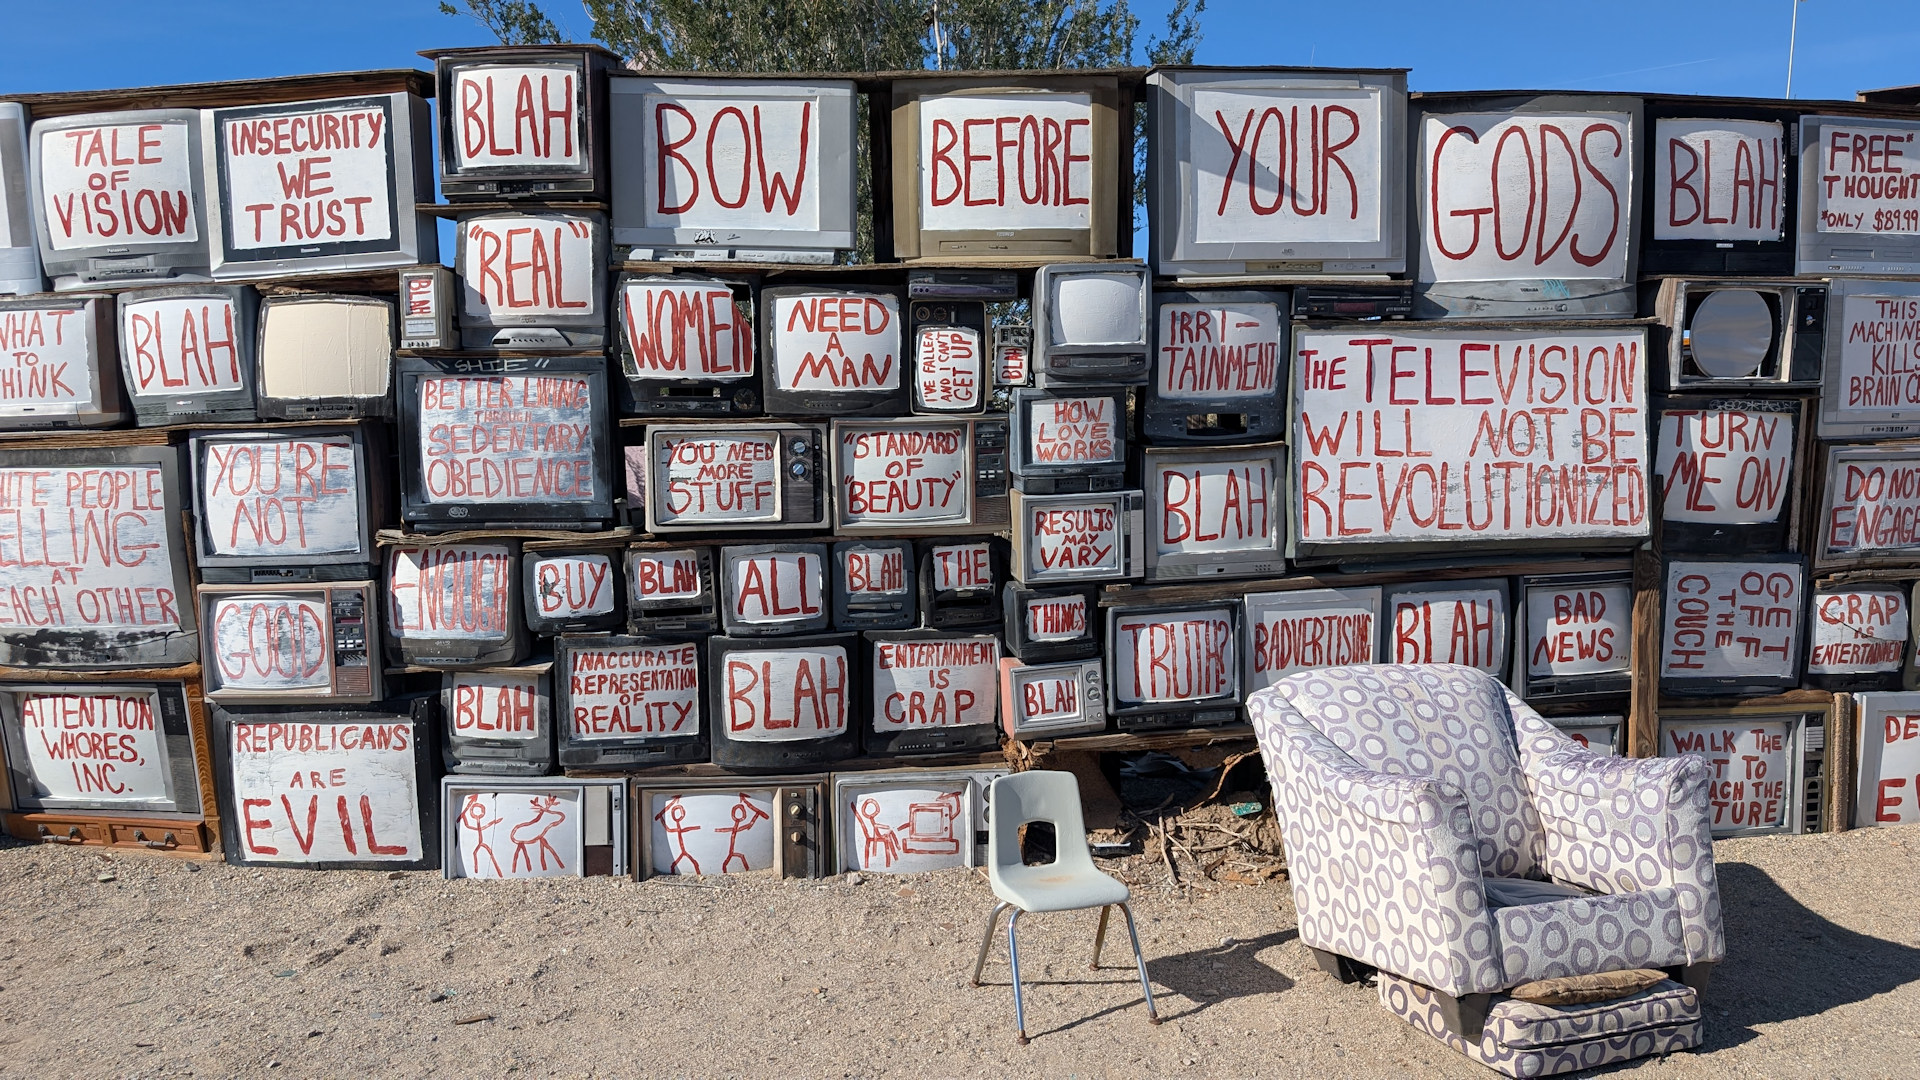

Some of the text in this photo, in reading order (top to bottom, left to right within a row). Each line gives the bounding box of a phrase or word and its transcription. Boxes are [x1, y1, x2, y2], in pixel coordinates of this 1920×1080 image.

[231, 113, 383, 156] INSECURITY
[462, 74, 572, 159] BLAH
[66, 125, 163, 167] TALE
[656, 102, 811, 216] BOW
[932, 114, 1090, 207] BEFORE
[1215, 105, 1359, 220] YOUR
[88, 170, 130, 191] OF
[278, 157, 333, 199] WE
[1432, 123, 1622, 267] GODS
[1669, 138, 1778, 230] BLAH
[53, 189, 188, 237] VISION
[245, 197, 372, 242] TRUST
[1872, 207, 1919, 232] $89.99
[469, 221, 589, 309] "REAL"
[409, 279, 431, 315] BLAH
[786, 297, 890, 335] NEED
[1876, 300, 1918, 320] THIS
[132, 303, 239, 390] BLAH
[624, 289, 753, 374] WOMEN
[826, 332, 844, 357] A
[936, 331, 950, 362] CAN'T
[13, 351, 39, 367] TO
[792, 351, 892, 388] MAN
[921, 331, 937, 403] I'VE FALLEN
[950, 333, 974, 401] GET UP
[1001, 347, 1024, 380] BLAH
[1162, 341, 1277, 392] TAINMENT
[1298, 338, 1637, 406] THE TELEVISION
[0, 361, 75, 399] HINK
[425, 376, 589, 411] BETTER LIVING
[940, 377, 952, 402] AND
[1848, 375, 1902, 407] BRAIN
[474, 410, 532, 424] THROUGH
[1054, 400, 1105, 424] HOW
[427, 423, 590, 456] SEDENTARY
[844, 429, 961, 459] "STANDARD"
[1036, 439, 1113, 462] WORKS
[1038, 423, 1109, 443] LOVE
[1301, 407, 1639, 465] WILL NOT BE
[1665, 410, 1778, 453] TURN
[211, 440, 350, 501] YOU'RE
[665, 438, 774, 467] YOU NEED
[696, 462, 753, 481] MORE
[885, 458, 924, 479] OF
[66, 470, 164, 511] PEOPLE
[427, 458, 593, 498] OBEDIENCE
[844, 471, 961, 514] "BEAUTY"
[1662, 451, 1786, 512] ME ON
[1845, 464, 1886, 502] DO
[666, 480, 772, 515] STUFF
[1162, 467, 1267, 544] BLAH
[1301, 460, 1646, 536] REVOLUTIONIZED
[231, 496, 318, 549] NOT
[1034, 508, 1113, 536] RESULTS
[1061, 533, 1099, 546] MAY
[1830, 504, 1920, 546] ENGAGE
[848, 547, 902, 592] BLAH
[935, 543, 990, 587] THE
[1040, 544, 1113, 569] VARY
[51, 567, 83, 585] AT
[391, 549, 508, 633] ENOUGH
[538, 562, 607, 613] BUY
[639, 559, 698, 595] BLAH
[737, 556, 819, 616] ALL
[0, 586, 180, 627] EACH OTHER
[1029, 601, 1085, 634] THINGS
[1553, 590, 1607, 626] BAD
[1668, 574, 1711, 669] COUCH
[1715, 588, 1737, 647] THE
[1736, 571, 1764, 657] OFF
[1762, 572, 1793, 662] GET
[1819, 594, 1900, 627] CRAP
[214, 603, 325, 679] GOOD
[1253, 612, 1373, 674] BADVERTISING
[1395, 599, 1493, 667] BLAH
[1854, 626, 1875, 639] IS
[573, 646, 695, 673] INACCURATE
[878, 642, 994, 670] ENTERTAINMENT
[1120, 620, 1230, 699] TRUTH?
[1810, 640, 1904, 665] ENTERTAINMENT
[570, 667, 697, 695] REPRESENTATION
[728, 655, 846, 732] BLAH
[929, 668, 950, 689] IS
[22, 693, 155, 731] ATTENTION
[455, 684, 535, 732] BLAH
[574, 700, 693, 734] REALITY
[619, 692, 645, 706] OF
[884, 690, 975, 725] CRAP
[1023, 679, 1077, 717] BLAH
[41, 730, 146, 767] WHORES,
[236, 722, 410, 753] REPUBLICANS
[1670, 728, 1783, 754] WALK THE
[71, 761, 134, 795] INC.
[290, 768, 347, 789] ARE
[1741, 755, 1767, 780] TO
[1751, 781, 1783, 799] THE
[242, 794, 408, 856] EVIL
